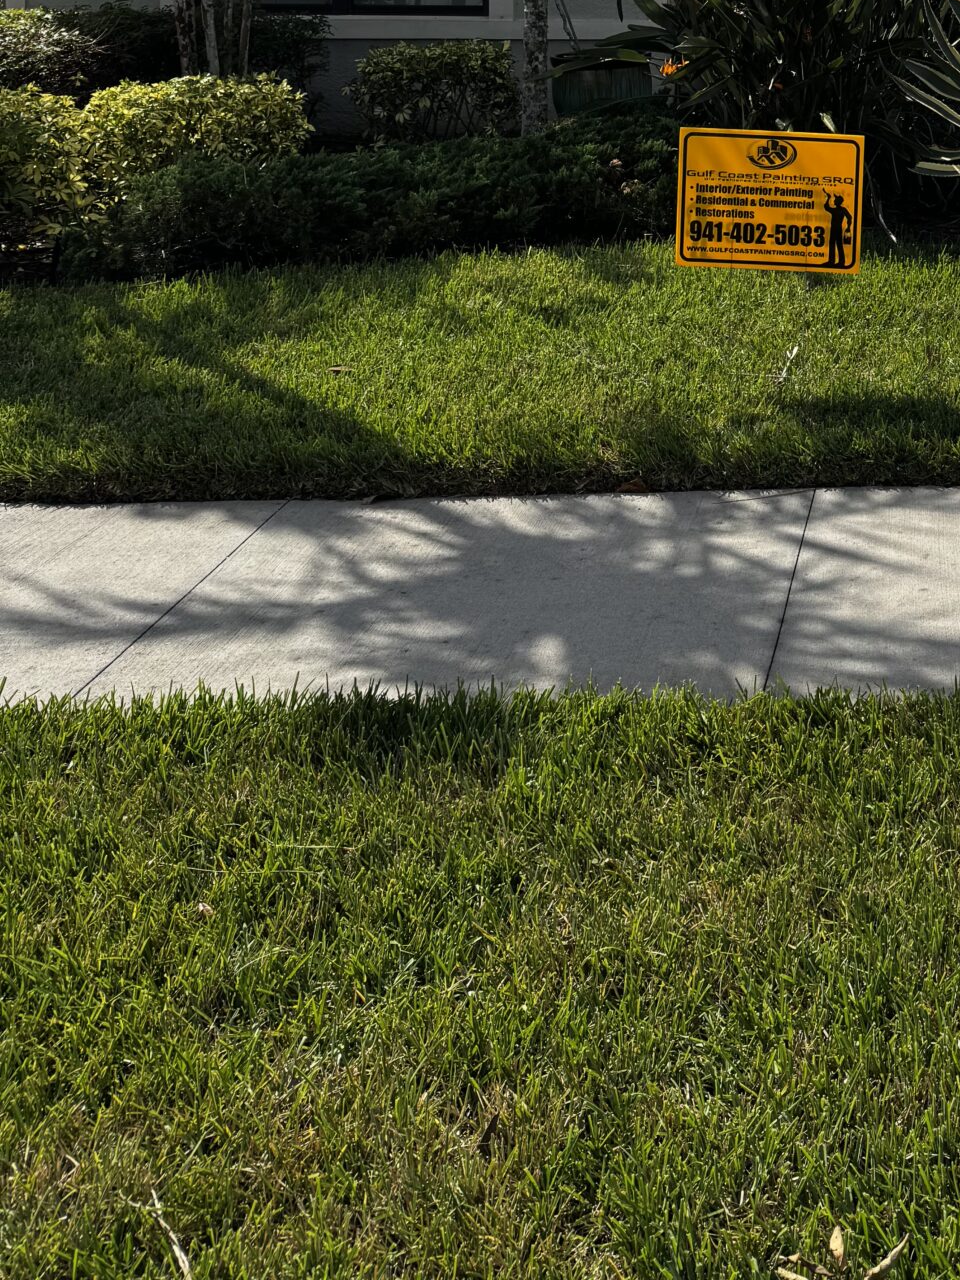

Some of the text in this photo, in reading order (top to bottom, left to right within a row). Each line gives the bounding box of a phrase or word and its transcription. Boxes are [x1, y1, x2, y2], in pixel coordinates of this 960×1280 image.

[687, 169, 715, 177] Gulf
[718, 171, 759, 180] Coast
[762, 173, 819, 184] Painting
[823, 176, 854, 185] SRQ
[696, 183, 813, 199] Interior/Exterior Painting
[695, 195, 815, 210] Residential & Commercial
[695, 207, 755, 219] Restorations
[689, 220, 825, 248] 941-402-5033
